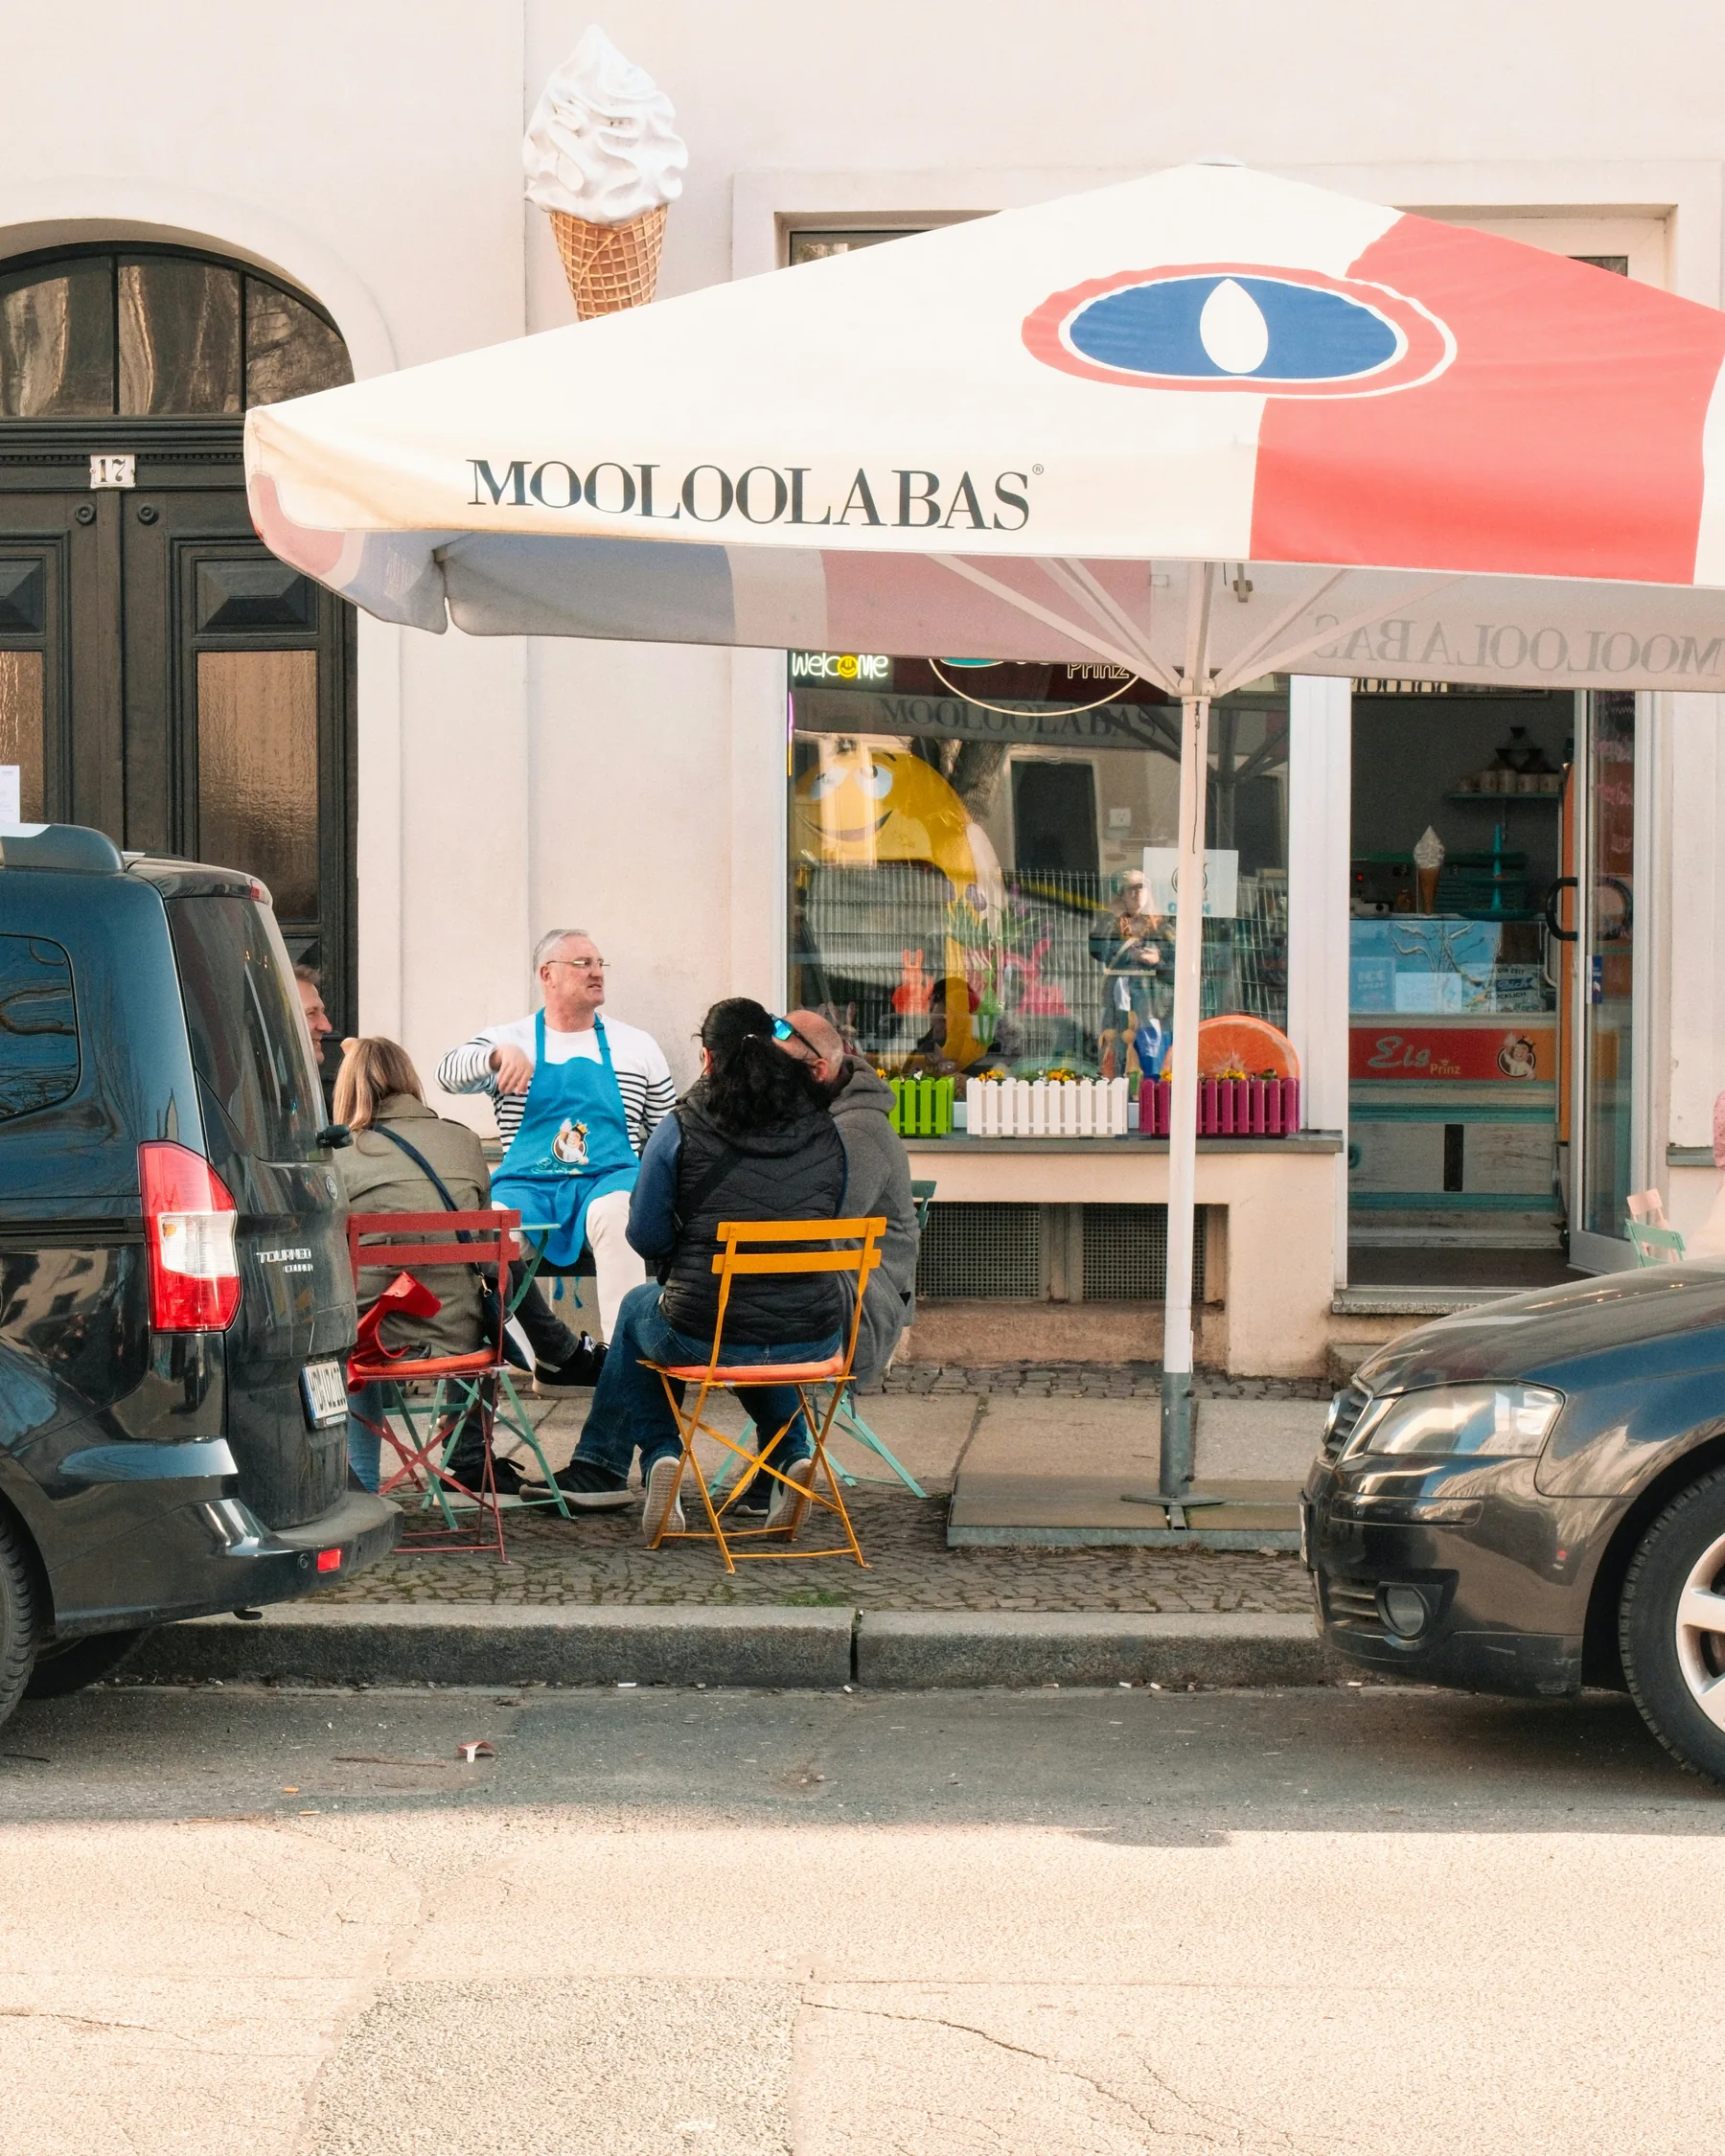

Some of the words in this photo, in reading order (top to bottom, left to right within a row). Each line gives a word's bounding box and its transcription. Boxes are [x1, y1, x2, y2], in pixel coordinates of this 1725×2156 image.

[99, 459, 126, 482] 17
[1368, 1035, 1431, 1068] Eis
[1430, 1063, 1461, 1074] Prinz
